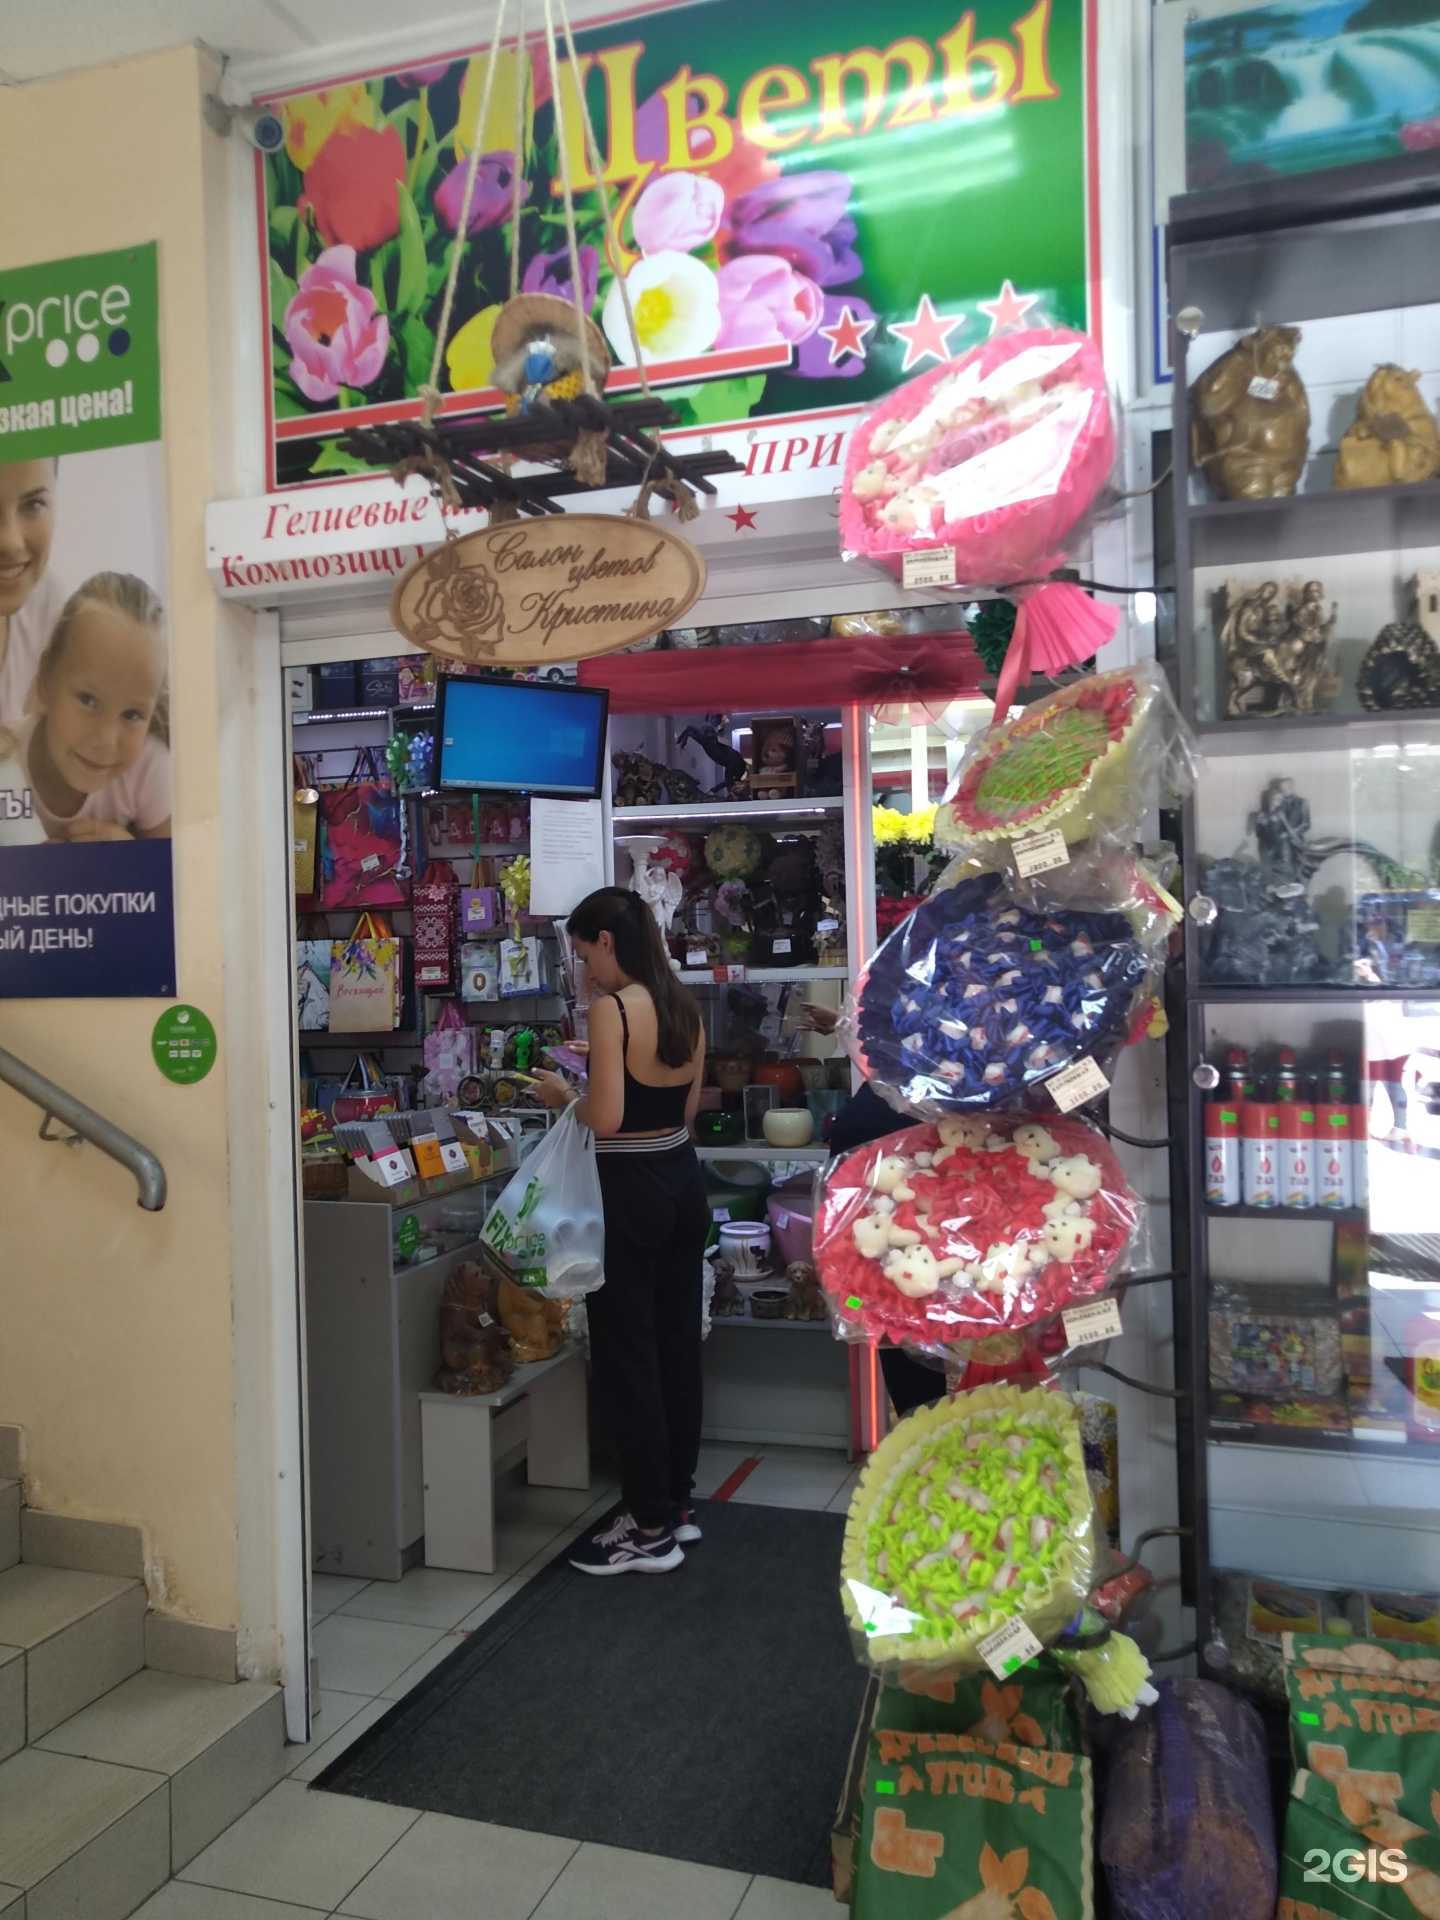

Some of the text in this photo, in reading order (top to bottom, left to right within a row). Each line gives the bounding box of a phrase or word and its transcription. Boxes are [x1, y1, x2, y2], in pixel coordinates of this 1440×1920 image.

[550, 0, 1060, 278] Цветы
[6, 285, 130, 355] price
[61, 380, 133, 427] цена!
[263, 495, 428, 540] Гелиевые
[487, 531, 584, 573] Салон
[568, 540, 666, 582] цветов
[507, 582, 676, 647] Кристина
[55, 891, 156, 916] ПОКУПКИ
[29, 927, 94, 953] ДЕНЬ!
